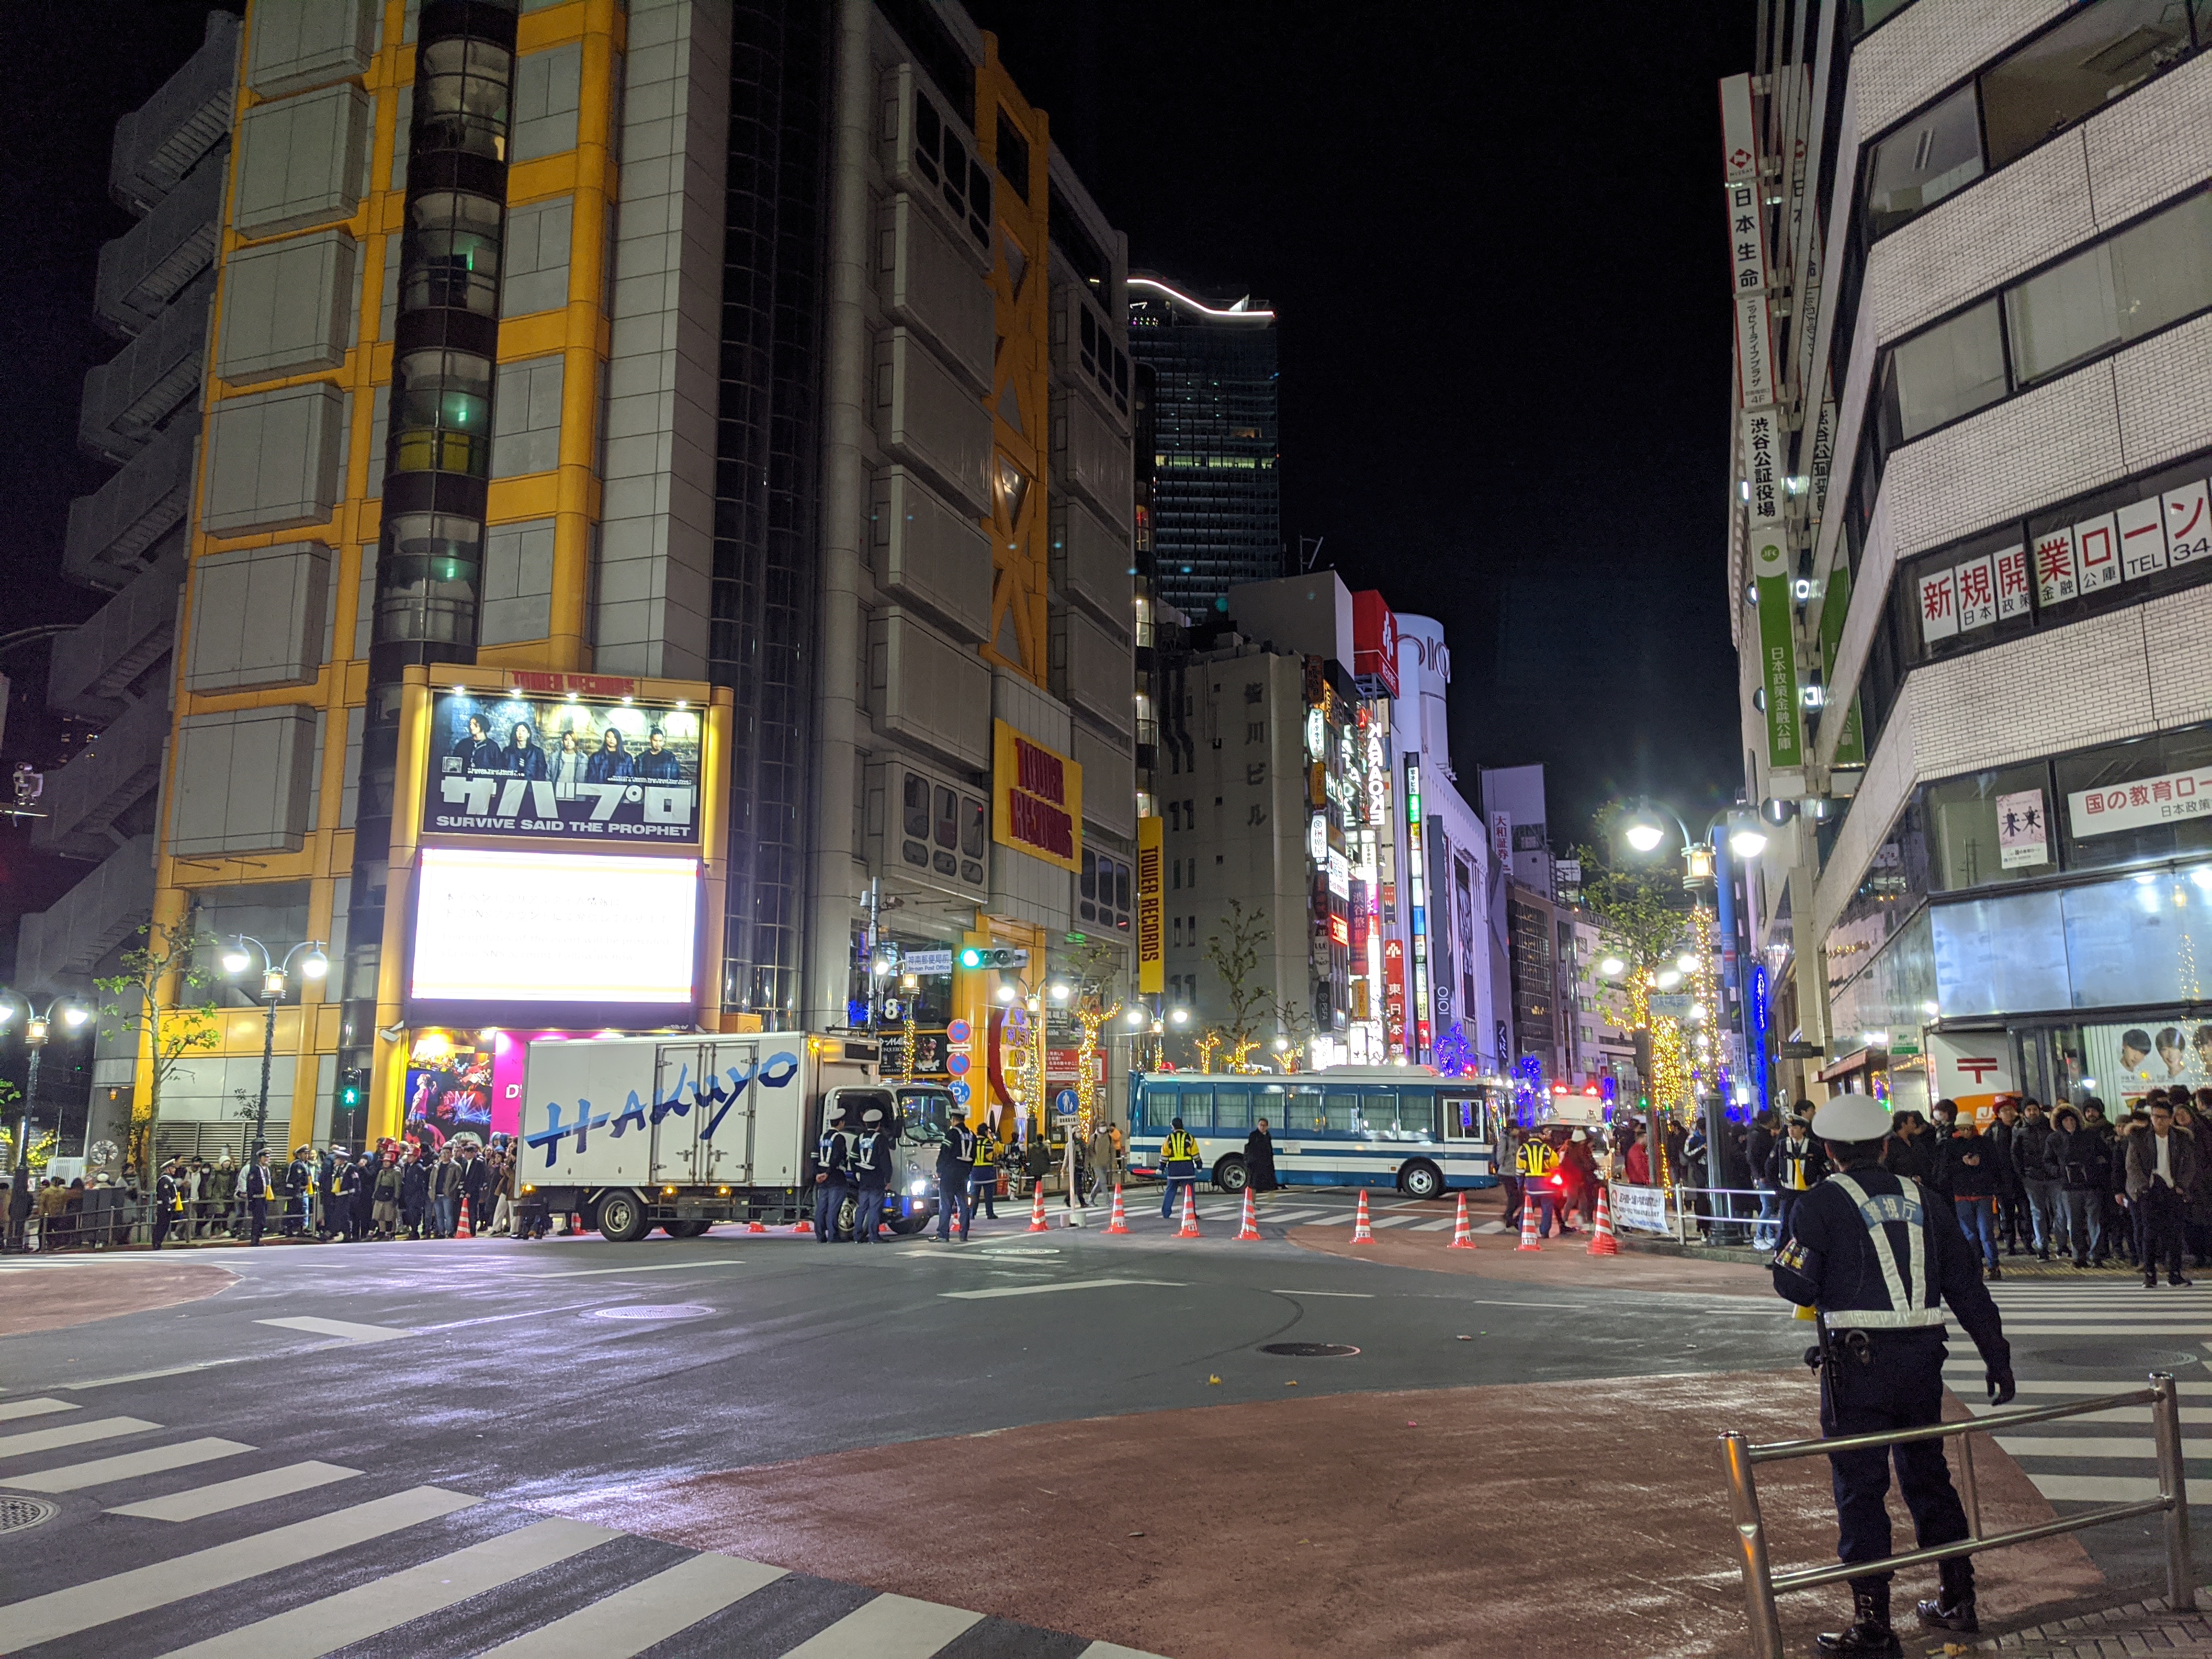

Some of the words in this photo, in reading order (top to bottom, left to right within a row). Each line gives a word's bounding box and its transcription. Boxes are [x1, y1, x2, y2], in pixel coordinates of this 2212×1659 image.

[1735, 188, 1759, 287] 日本生命
[1751, 417, 1775, 518] 渋谷公証役場
[1923, 496, 2204, 621] 新規開業ローン
[2129, 553, 2163, 574] TEL
[1771, 647, 1792, 751] 日本政策金融公庫
[436, 815, 515, 830] SURVIVE
[521, 819, 564, 831] SAID
[569, 821, 603, 833] THE
[608, 823, 691, 837] PROPHET
[1495, 815, 1509, 860] 大和証券
[1141, 845, 1158, 895] TOWER
[1141, 897, 1159, 962] RECORDS
[909, 954, 949, 965] 神南郵便局前
[1864, 1197, 1917, 1223] 警視庁
